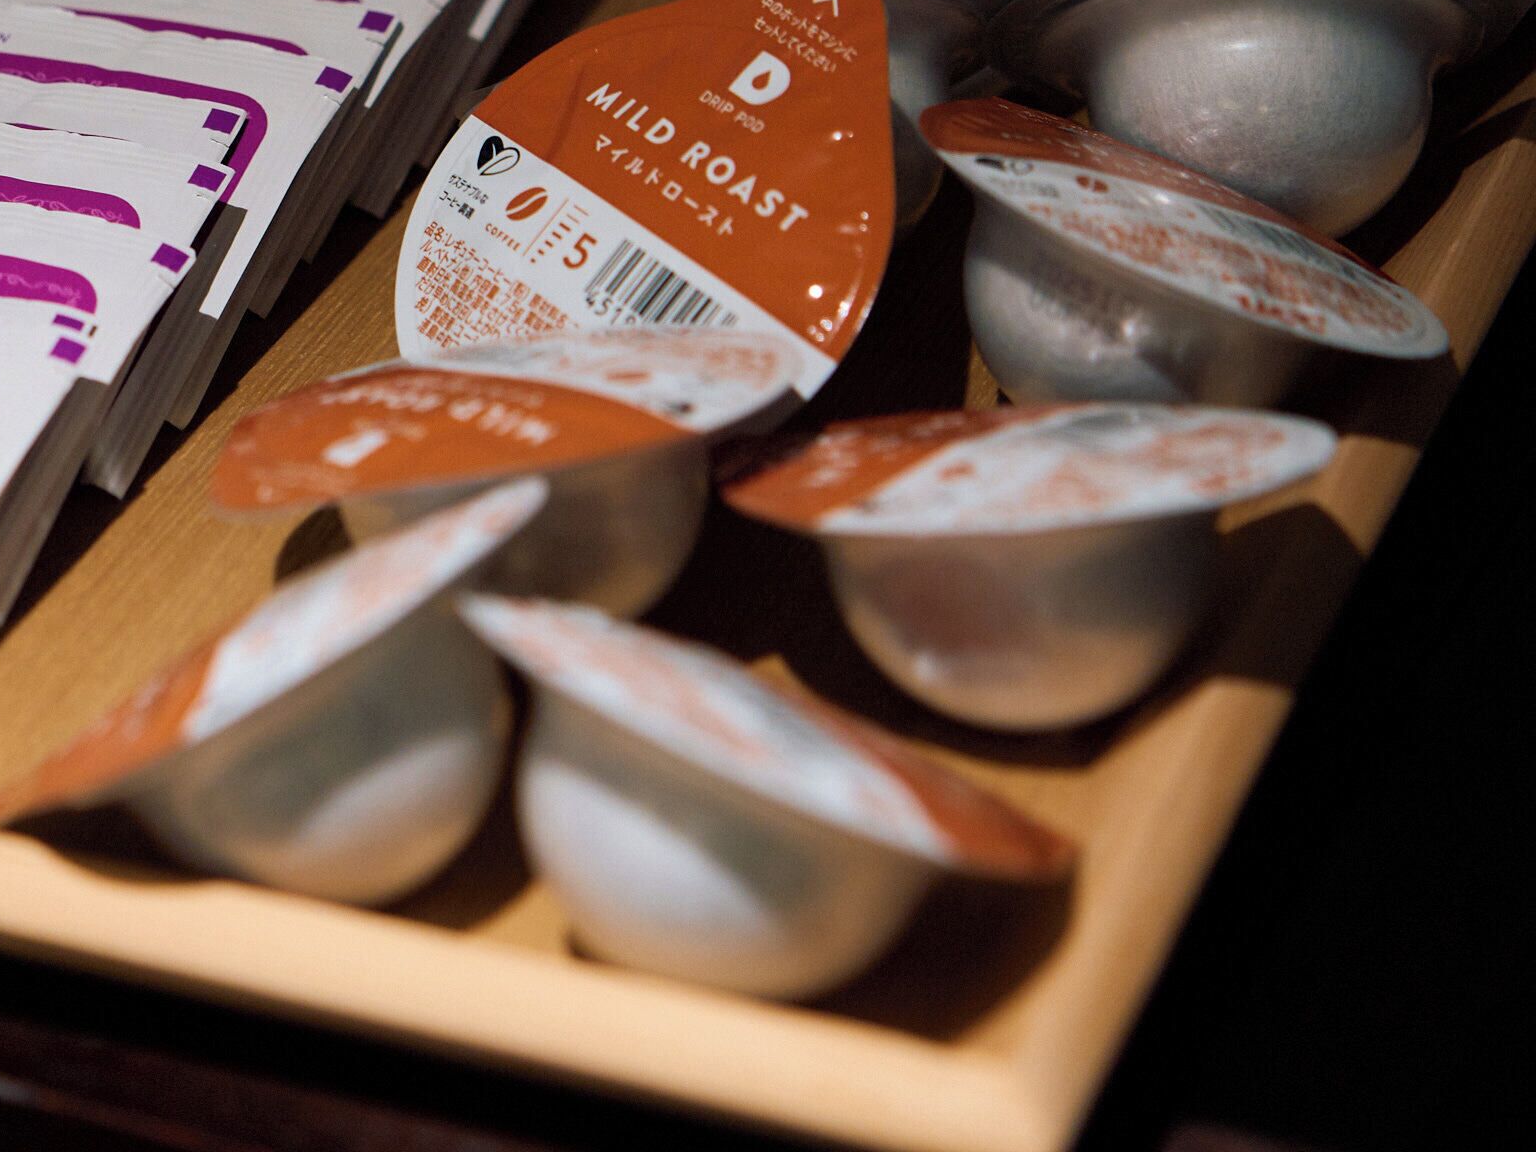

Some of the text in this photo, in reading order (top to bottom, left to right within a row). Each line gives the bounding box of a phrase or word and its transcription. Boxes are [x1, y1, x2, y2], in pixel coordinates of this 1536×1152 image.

[698, 89, 766, 134] DRIP POD
[586, 82, 809, 232] MILD ROAST
[594, 133, 735, 237] マイルドロースト
[484, 221, 522, 252] COFFEE
[562, 231, 598, 270] 5
